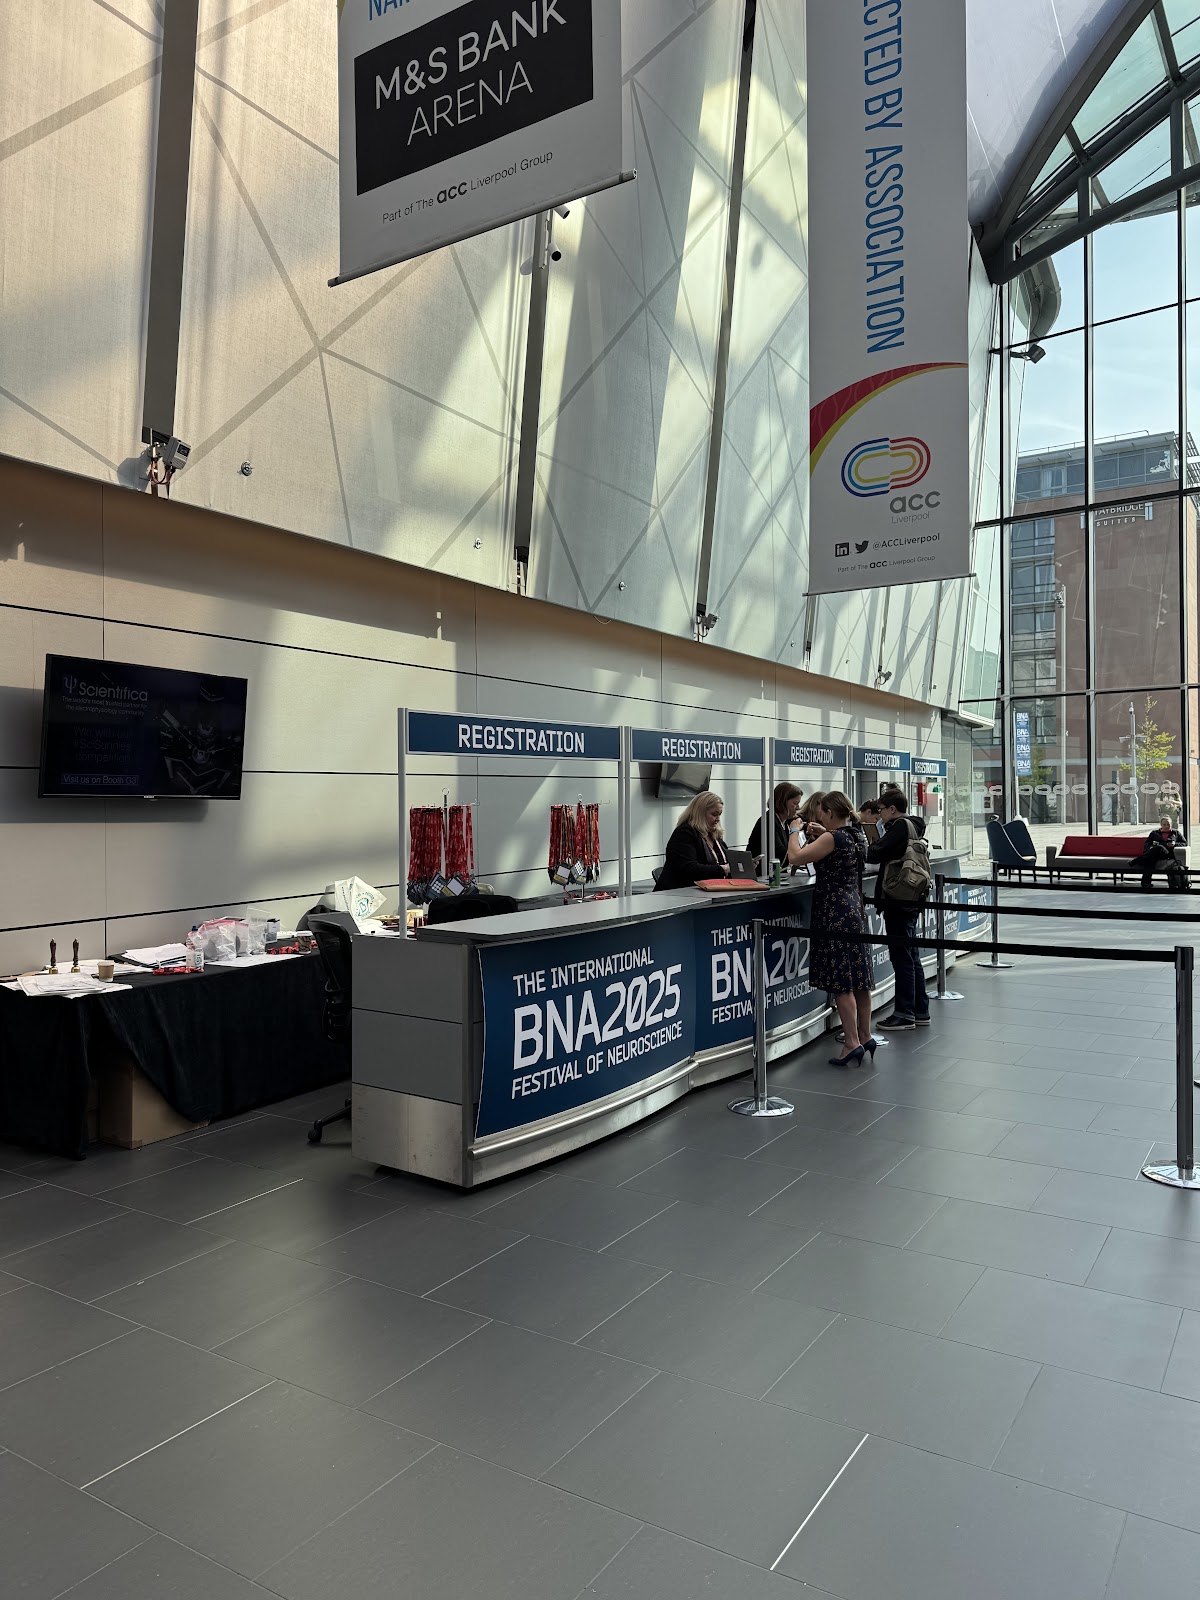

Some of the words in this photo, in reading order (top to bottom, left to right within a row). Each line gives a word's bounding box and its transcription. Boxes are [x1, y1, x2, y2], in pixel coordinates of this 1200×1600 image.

[375, 47, 447, 110] M&S
[458, 0, 567, 72] BANK
[407, 61, 534, 146] ARENA
[864, 87, 903, 132] BY
[382, 208, 402, 224] Part
[404, 204, 414, 217] of
[416, 198, 434, 213] The
[436, 182, 468, 204] acc
[470, 163, 518, 192] Liverpool
[520, 151, 554, 171] Group
[864, 144, 905, 354] ASSOCIATION
[889, 491, 941, 513] acc
[891, 511, 930, 525] Liverpool
[872, 533, 940, 550] @ACCLiverpool
[869, 560, 888, 569] acc
[888, 557, 916, 567] Liverpool
[916, 555, 936, 564] Group
[78, 681, 149, 702] Scientifica
[458, 723, 585, 754] REGISTRATION
[661, 737, 741, 760] REGISTRATION
[790, 745, 834, 764] REGISTRATION
[864, 752, 900, 768] REGISTRATION
[914, 761, 940, 774] REGISTRATION
[63, 774, 79, 784] Visit
[80, 776, 90, 784] us
[91, 776, 101, 785] on
[102, 775, 124, 785] Booth
[125, 776, 137, 785] G3
[711, 927, 734, 946] THE
[512, 970, 547, 997] THE
[550, 946, 655, 990] INTERNATIONAL
[712, 999, 753, 1025] FESTIVA
[511, 1064, 583, 1100] FESTIVAL
[586, 1054, 604, 1076] OF
[607, 1020, 683, 1068] NEUROSCIENCE
